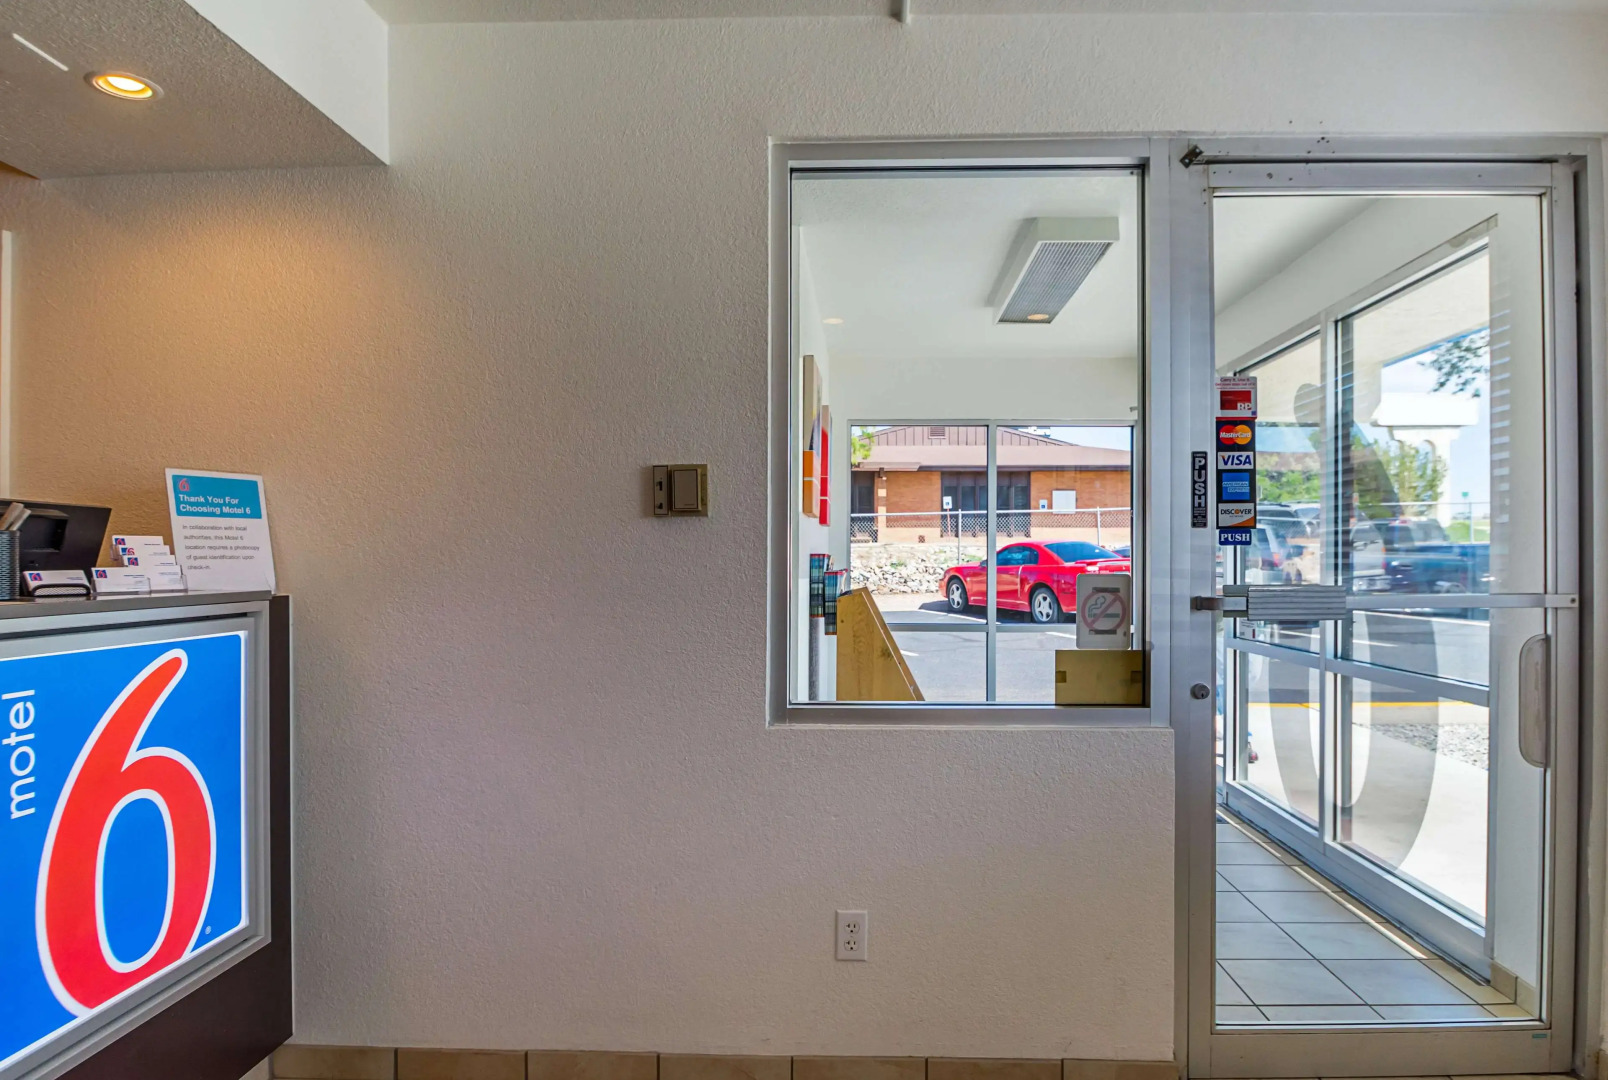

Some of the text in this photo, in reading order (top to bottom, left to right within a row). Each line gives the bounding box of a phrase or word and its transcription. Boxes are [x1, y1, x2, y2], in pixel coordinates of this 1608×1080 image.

[1219, 454, 1252, 466] VISA
[1193, 457, 1206, 507] PUSH
[178, 494, 239, 504] Thank You For
[180, 505, 220, 514] Choosing
[222, 506, 244, 514] Motel
[1220, 533, 1251, 542] PUSH
[1, 648, 218, 1019] motel 6
